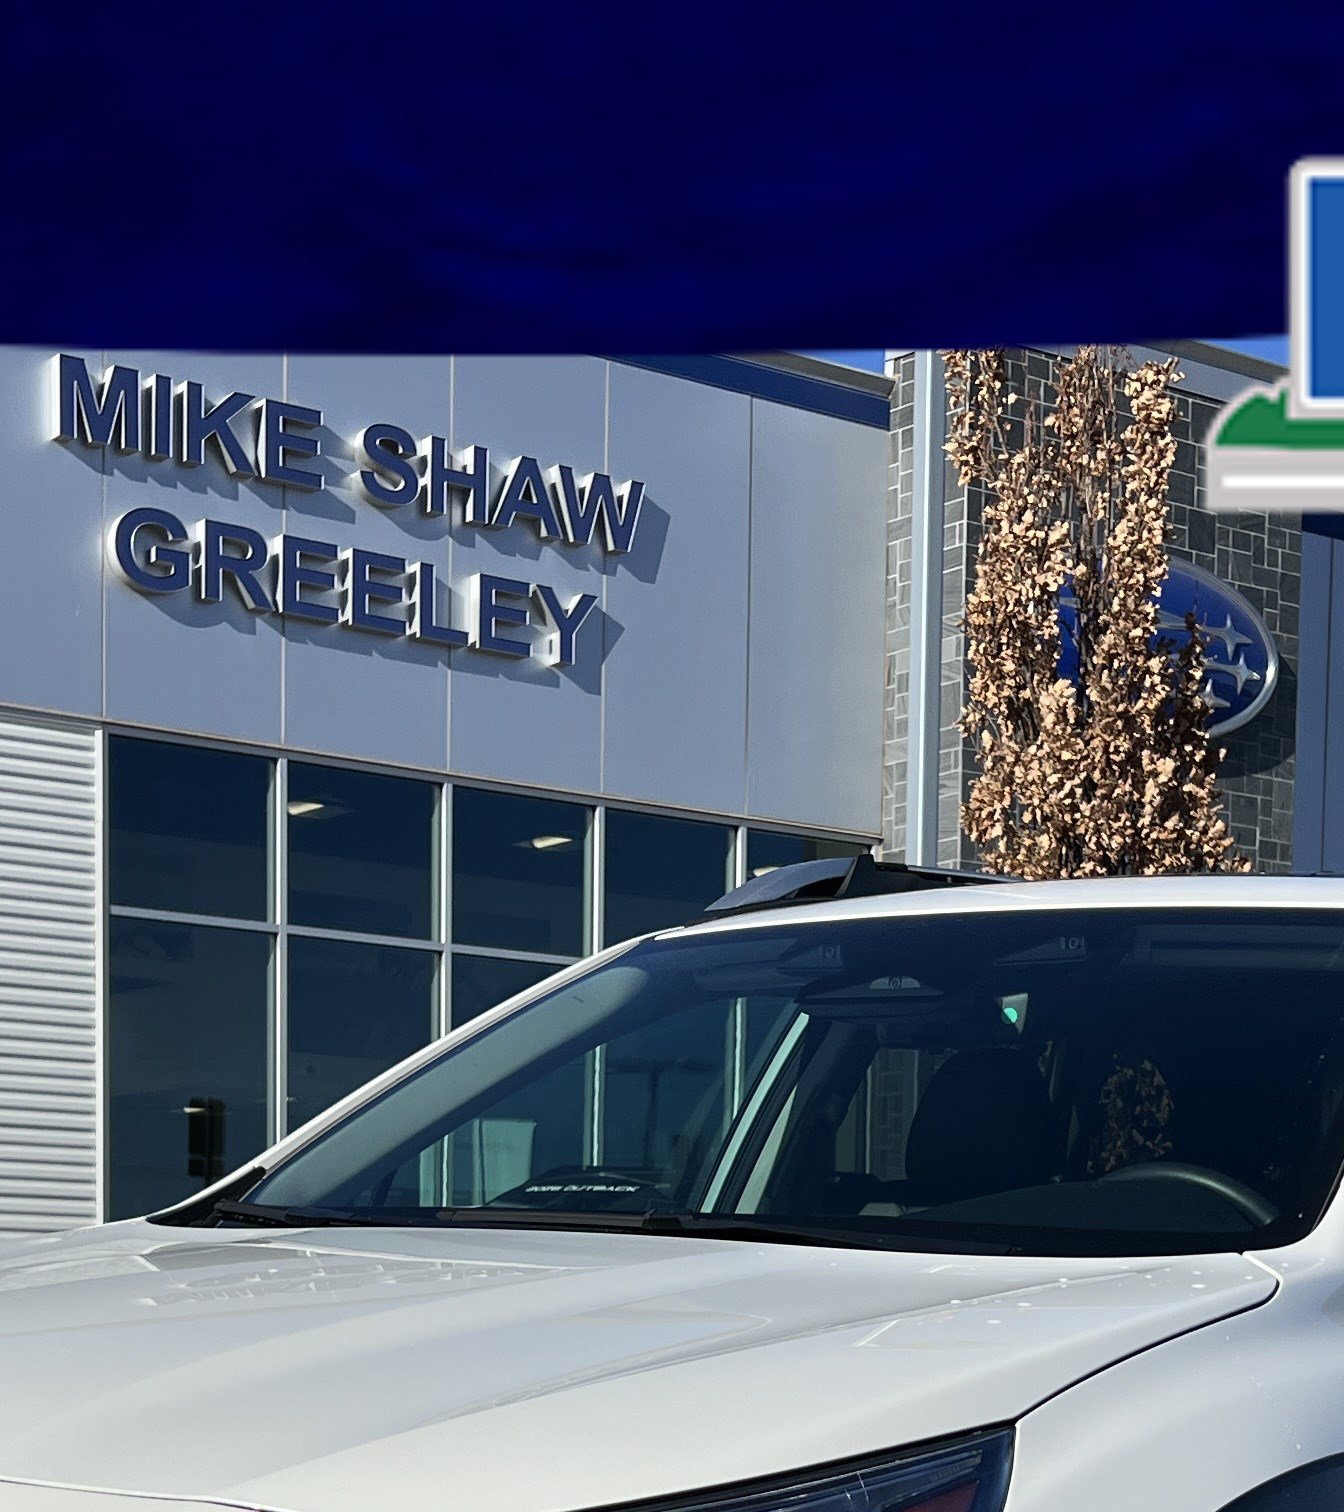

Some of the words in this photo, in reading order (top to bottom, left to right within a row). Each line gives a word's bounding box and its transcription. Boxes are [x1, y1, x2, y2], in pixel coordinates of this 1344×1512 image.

[53, 352, 325, 492] MIKE
[355, 423, 646, 555] SHAW
[109, 506, 597, 667] GREELEY
